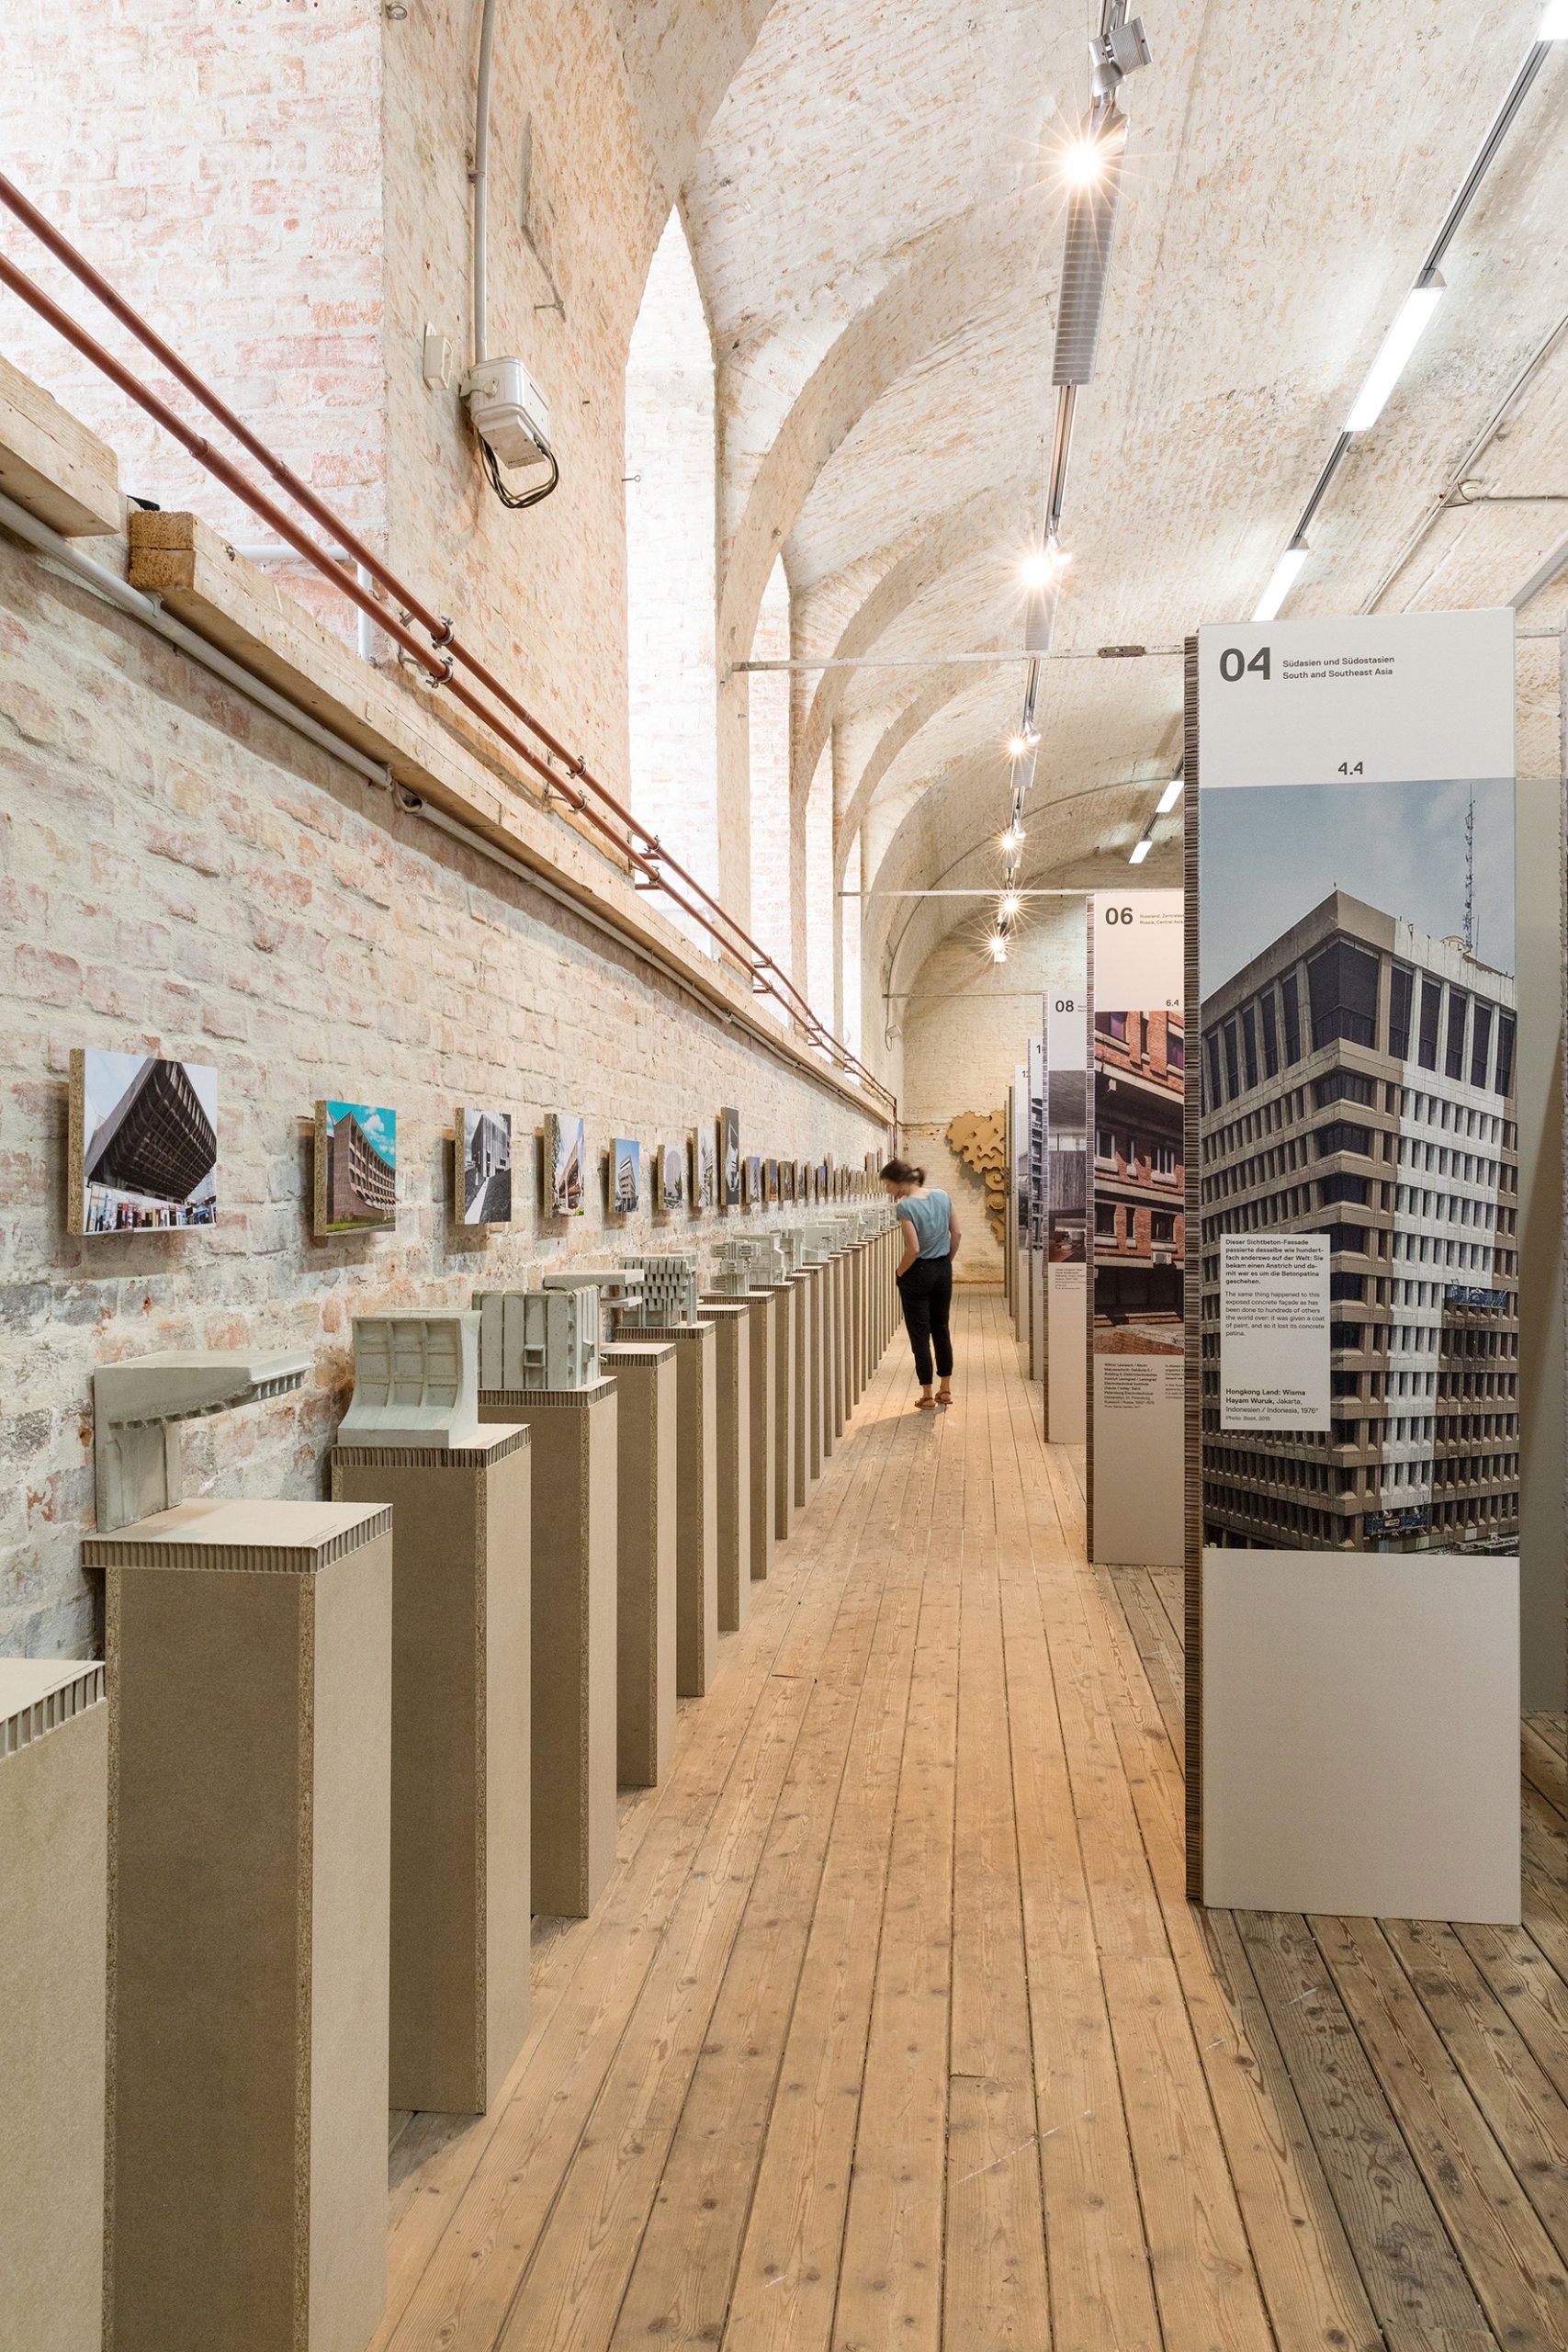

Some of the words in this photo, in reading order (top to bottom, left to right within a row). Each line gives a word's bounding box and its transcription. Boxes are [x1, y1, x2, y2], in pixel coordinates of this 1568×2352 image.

[1220, 647, 1270, 682] 04
[1283, 660, 1321, 668] Südasien
[1324, 658, 1340, 666] und
[1342, 656, 1394, 665] Südostasien
[1283, 671, 1309, 680] South
[1328, 669, 1372, 678] Southeast
[1337, 762, 1363, 775] 4.4
[1105, 907, 1134, 926] 06
[1055, 1000, 1074, 1012] 08
[1166, 999, 1179, 1007] 6.4
